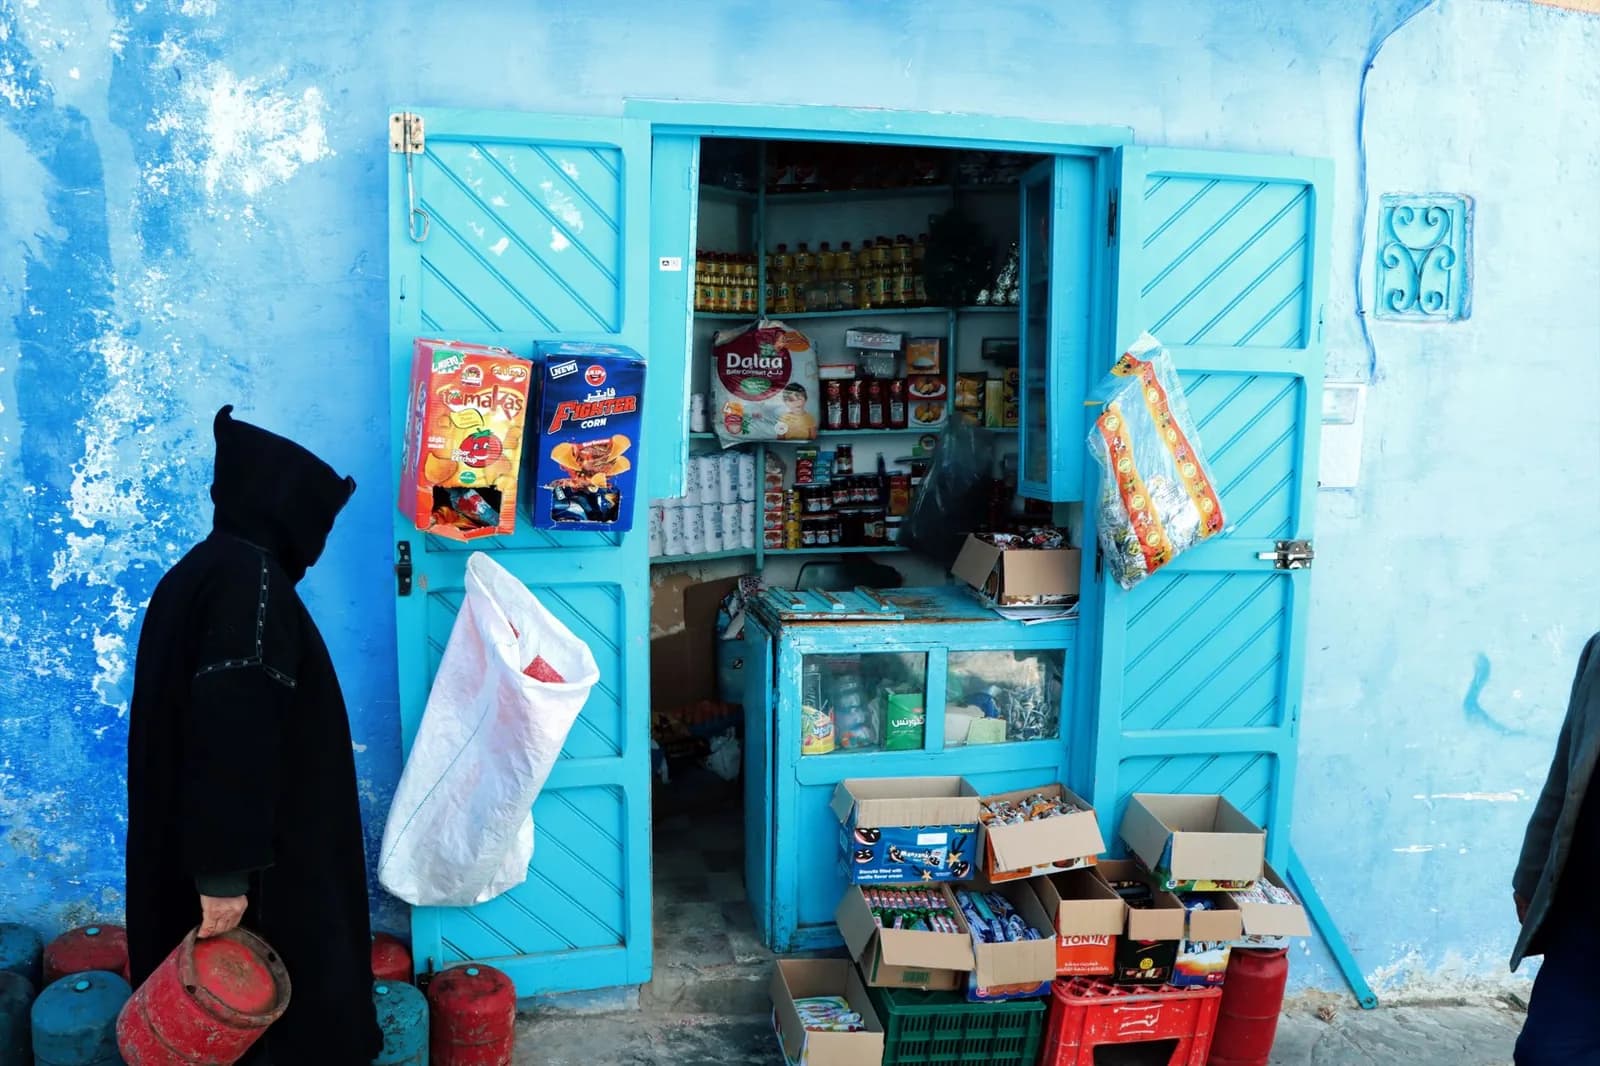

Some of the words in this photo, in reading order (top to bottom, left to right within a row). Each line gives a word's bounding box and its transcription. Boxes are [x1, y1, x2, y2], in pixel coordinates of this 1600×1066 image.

[726, 352, 783, 369] Dalaa
[553, 363, 576, 376] NEW
[443, 384, 524, 421] tomakas
[547, 396, 637, 435] FIGHTER
[580, 418, 608, 430] CORN
